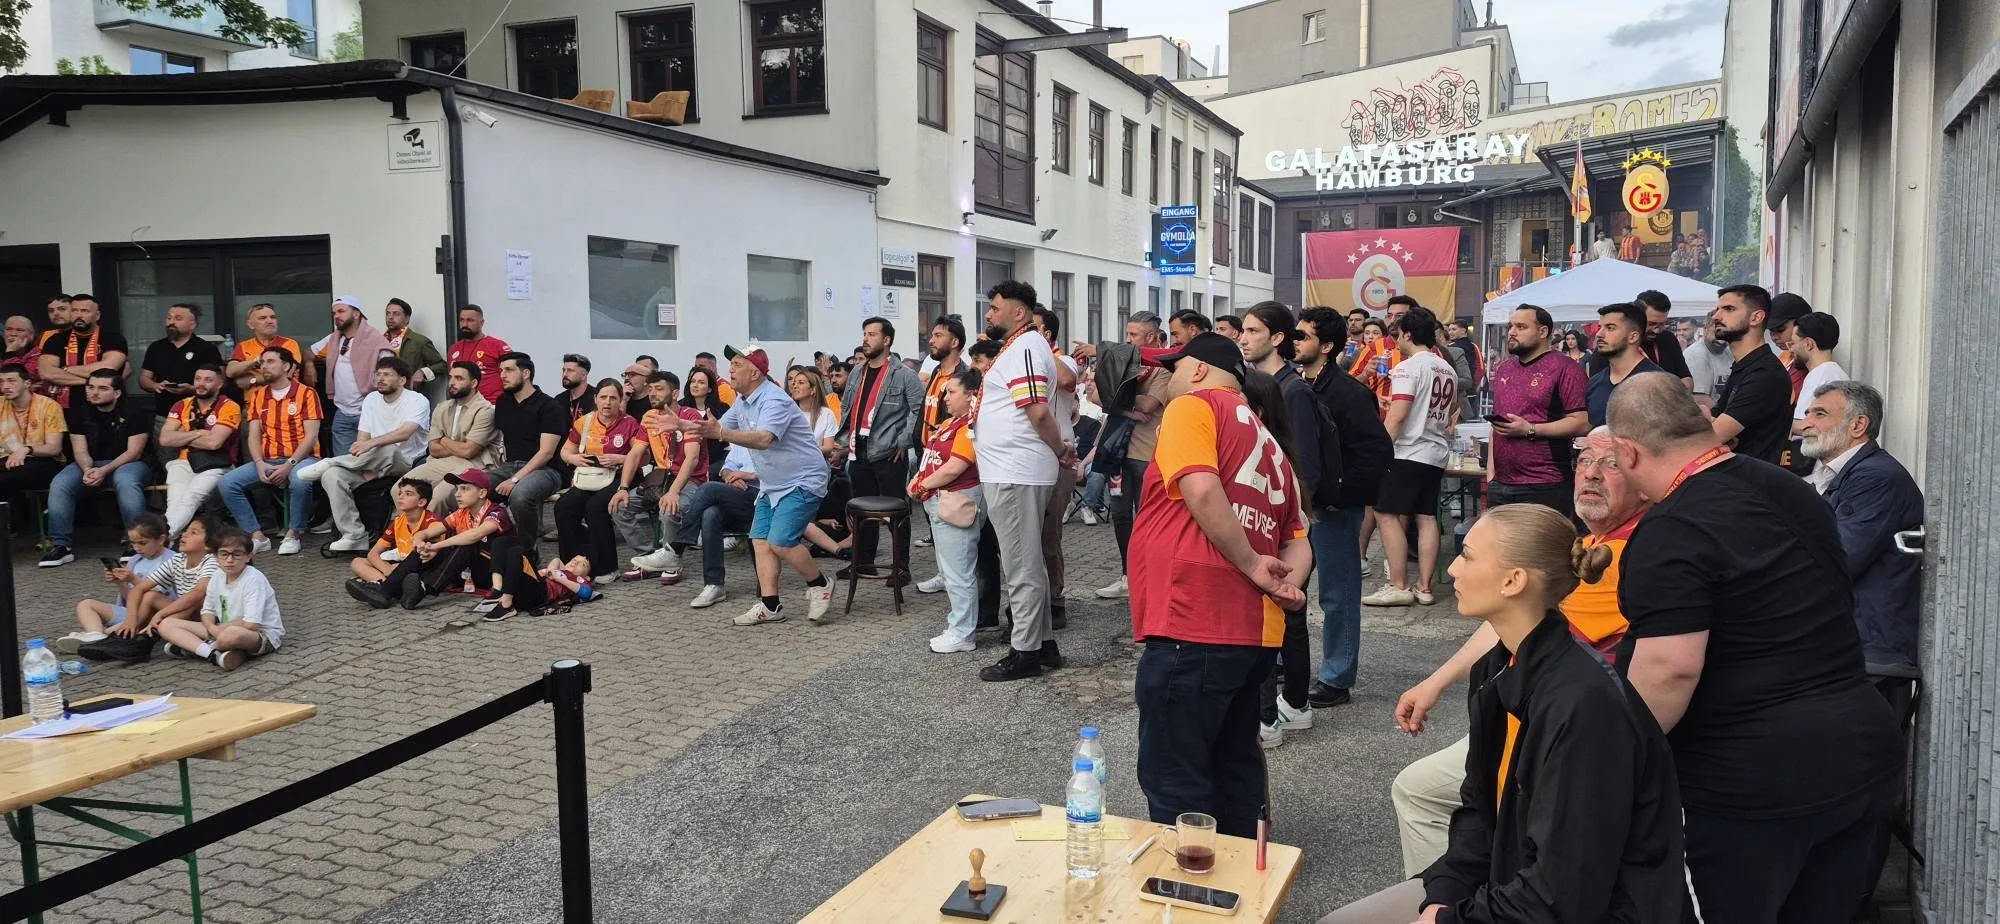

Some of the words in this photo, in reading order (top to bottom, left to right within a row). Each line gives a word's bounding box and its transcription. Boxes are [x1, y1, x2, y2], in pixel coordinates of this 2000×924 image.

[1265, 133, 1530, 172] GALATASARAY
[1316, 163, 1475, 191] HAMBURG
[1162, 208, 1195, 217] EINGANG
[1161, 231, 1195, 242] GYMOLLA
[1429, 375, 1454, 411] 99
[1234, 404, 1286, 505] 23
